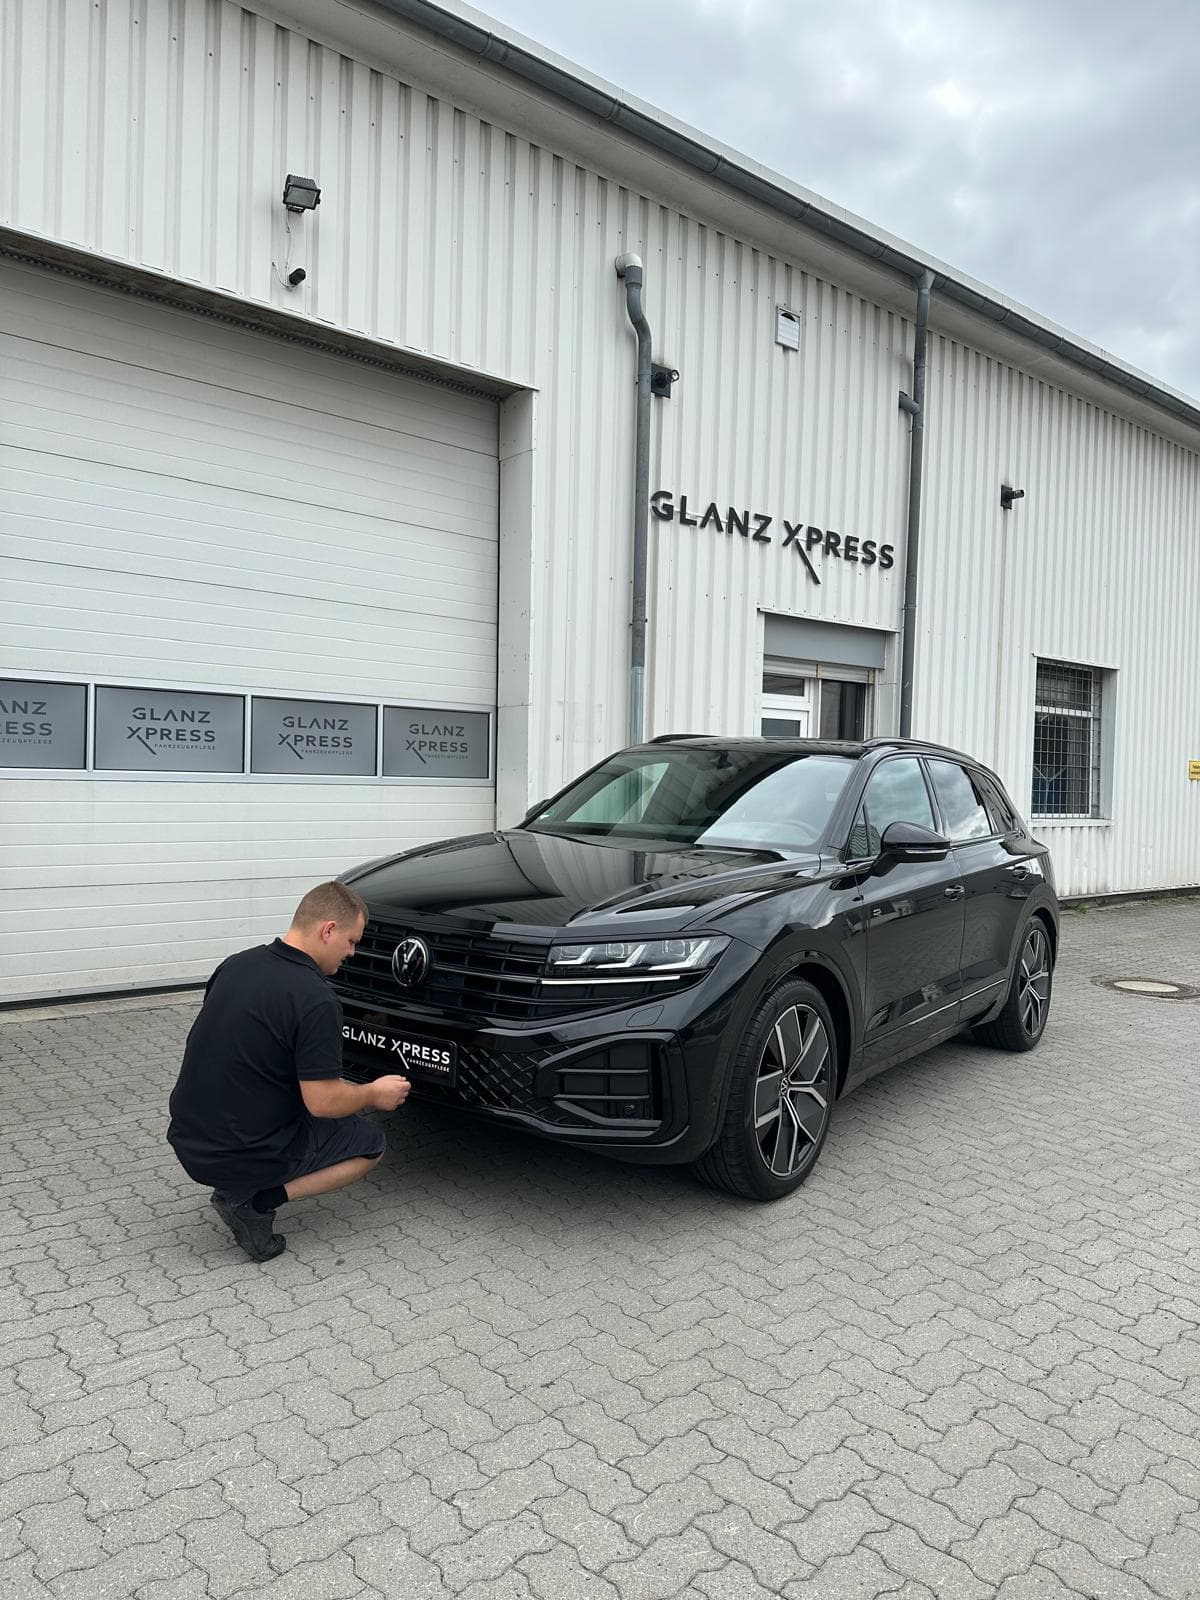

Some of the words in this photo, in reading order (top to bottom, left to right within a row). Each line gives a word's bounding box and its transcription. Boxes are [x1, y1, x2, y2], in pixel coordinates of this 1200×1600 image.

[650, 490, 773, 543] GLANZ
[782, 520, 895, 585] XPRESS
[132, 707, 211, 723] GLANZ
[282, 716, 349, 731] GLANZ
[0, 721, 53, 736] ESS
[126, 726, 216, 755] XPRESS
[408, 723, 465, 737] GLANZ
[278, 733, 353, 760] XPRESS
[405, 739, 469, 764] XPRESS
[341, 1025, 386, 1049] GLANZ
[390, 1038, 451, 1070] XPRESS
